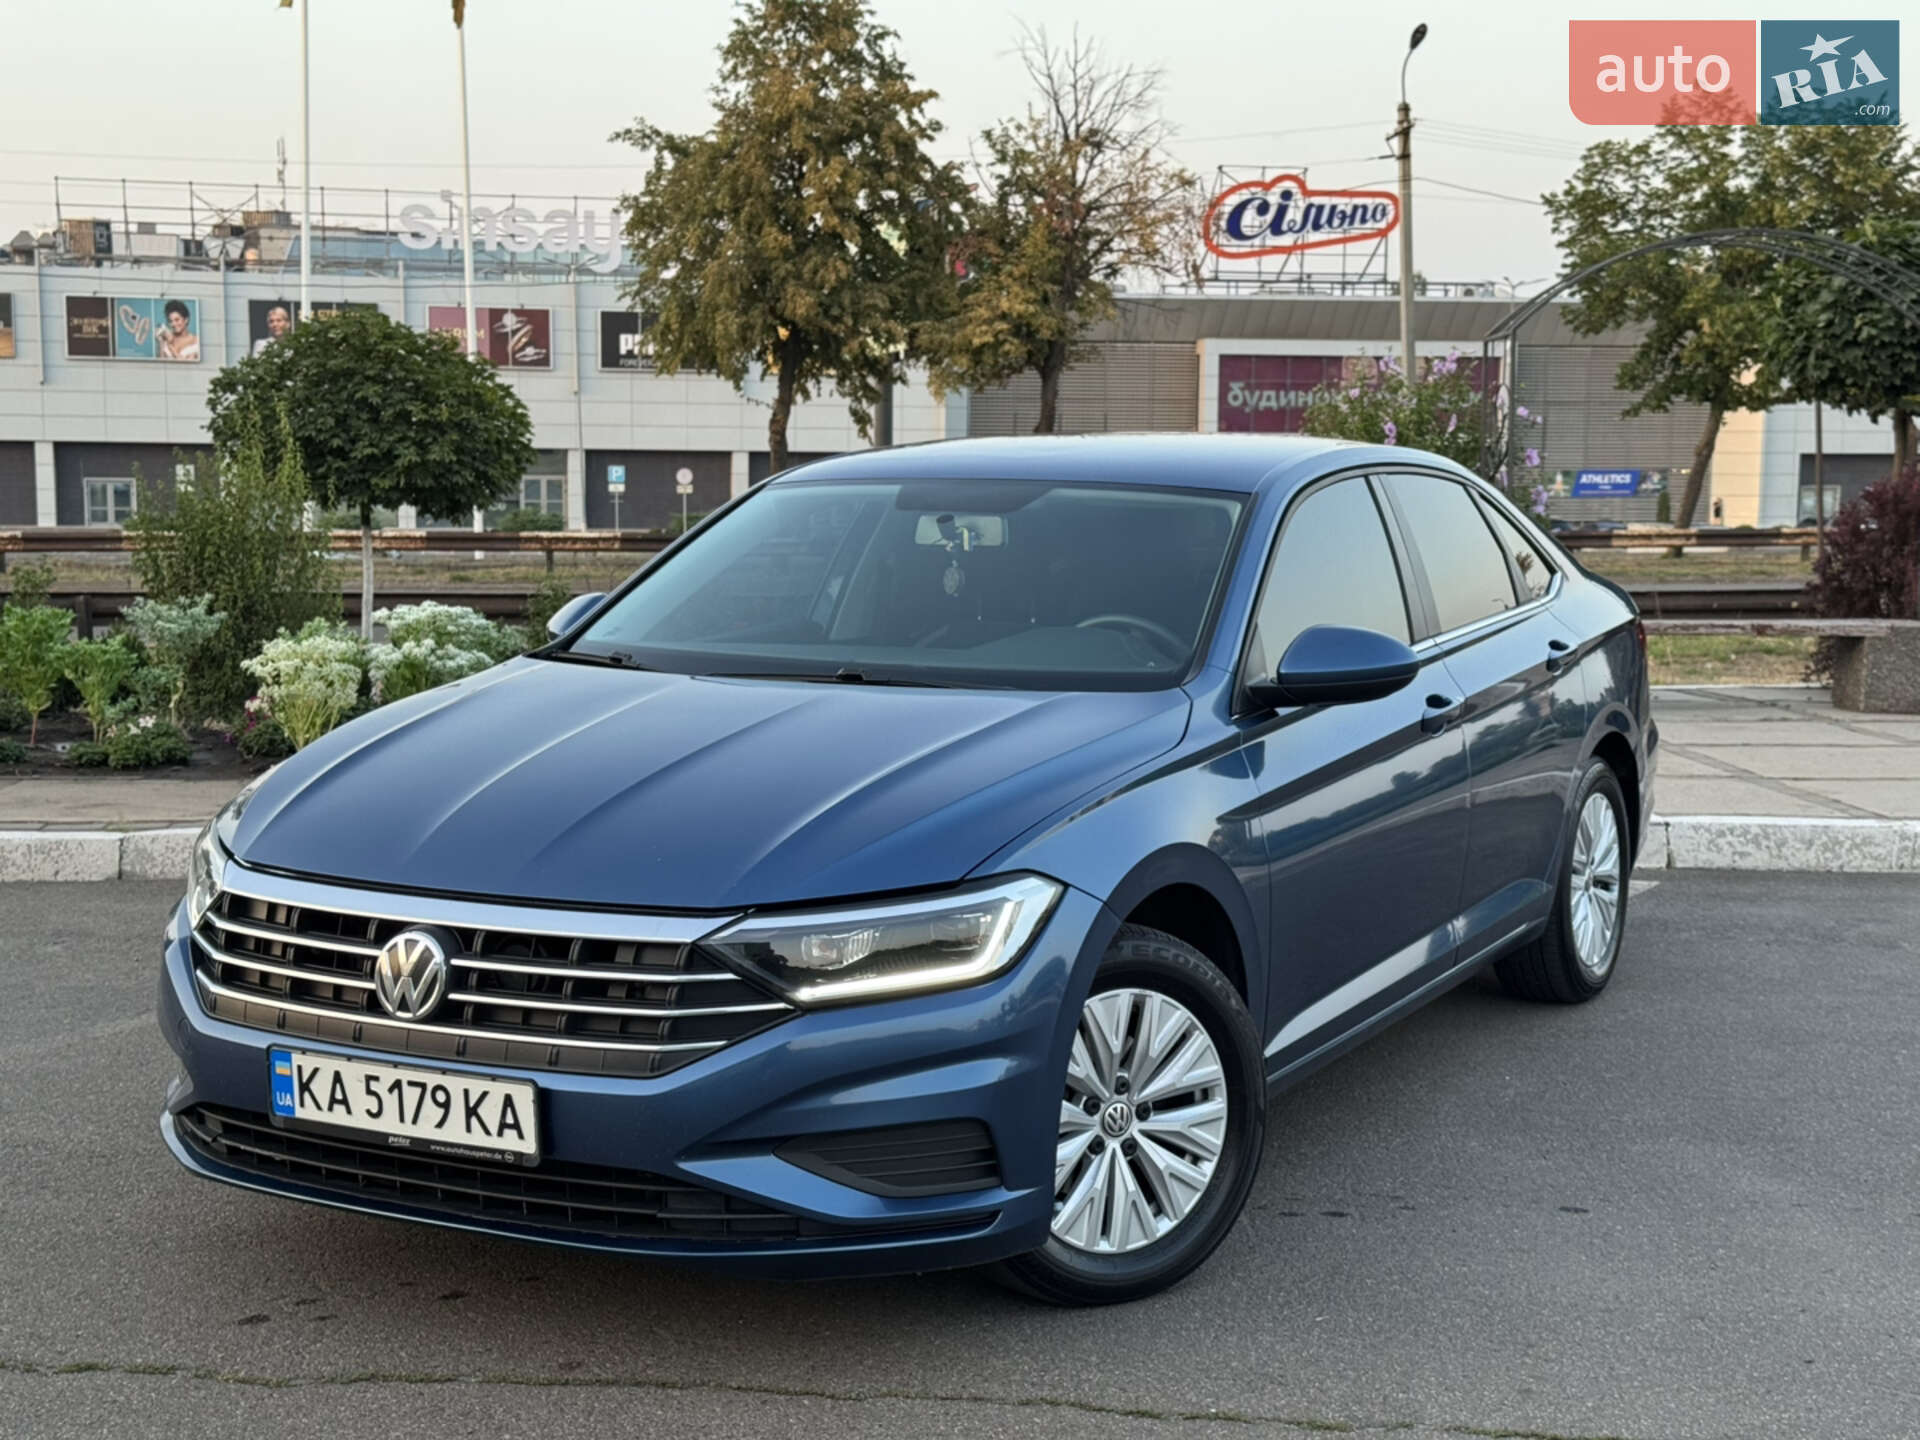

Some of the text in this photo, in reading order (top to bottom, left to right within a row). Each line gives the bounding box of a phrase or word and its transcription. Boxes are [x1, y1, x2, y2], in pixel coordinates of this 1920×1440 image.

[399, 190, 622, 274] sinsay
[1226, 189, 1388, 241] Сільпо
[1580, 473, 1632, 484] ATHLETICS
[276, 1091, 294, 1107] UA
[296, 1063, 526, 1140] KA 5179 KA
